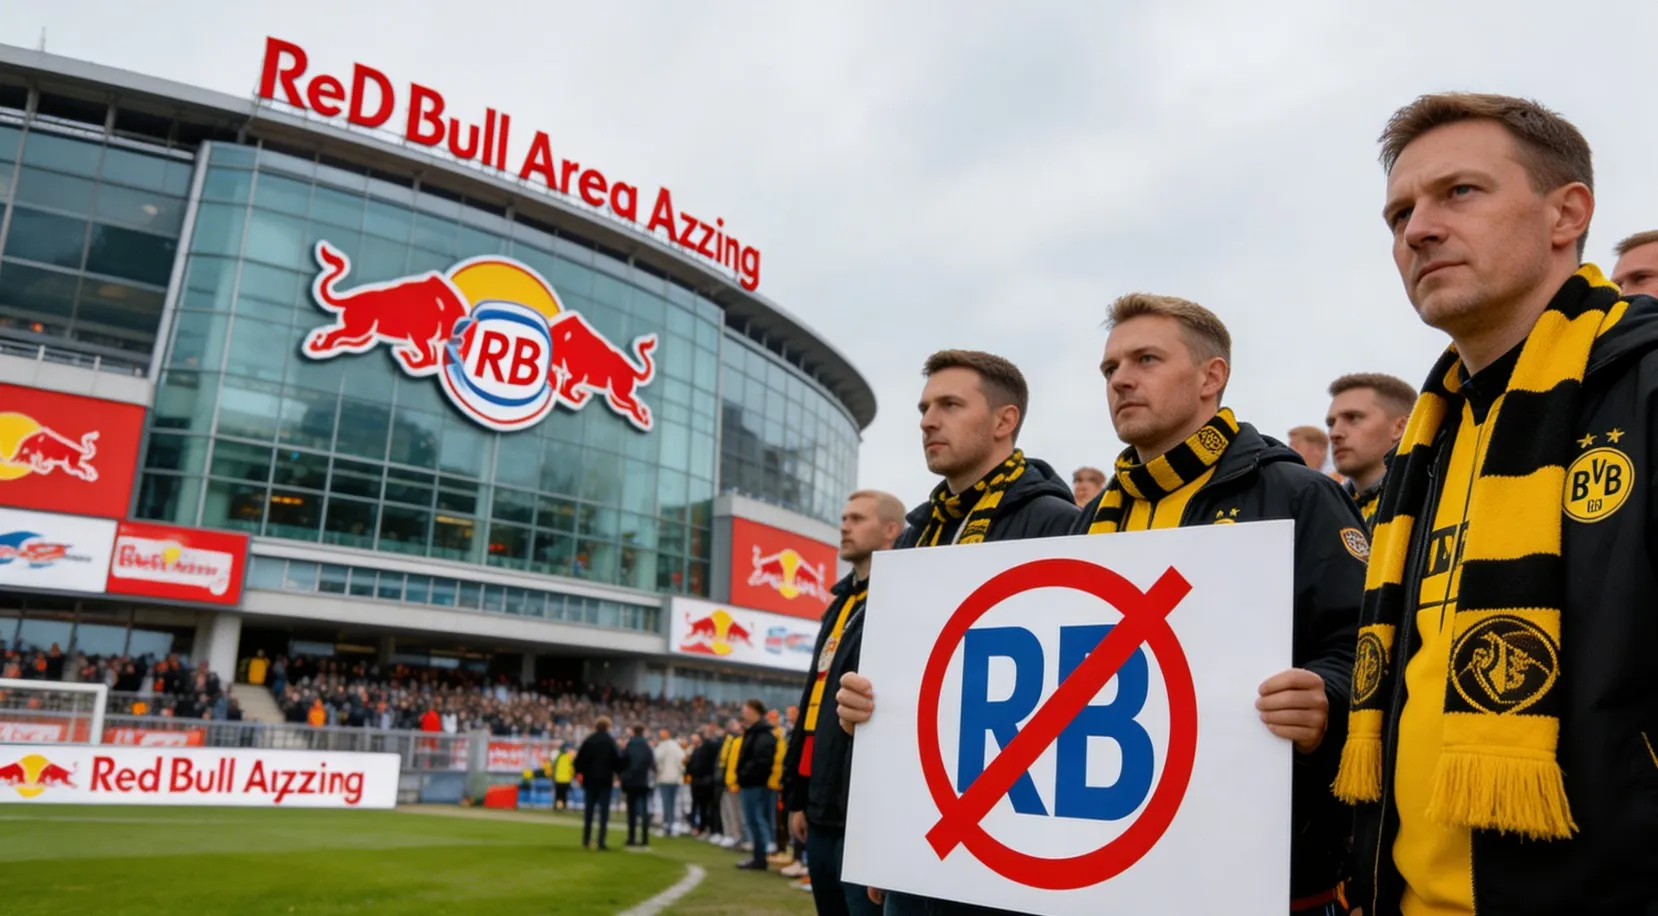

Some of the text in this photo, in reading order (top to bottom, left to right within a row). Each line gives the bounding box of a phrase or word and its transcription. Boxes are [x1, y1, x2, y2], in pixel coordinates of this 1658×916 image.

[405, 82, 511, 171] Bull
[518, 130, 638, 223] Area
[646, 186, 761, 292] Azzing
[474, 329, 542, 386] RB
[1570, 457, 1622, 503] BVB
[955, 621, 1156, 822] RB
[89, 755, 163, 793] Red
[168, 756, 236, 794] Bull
